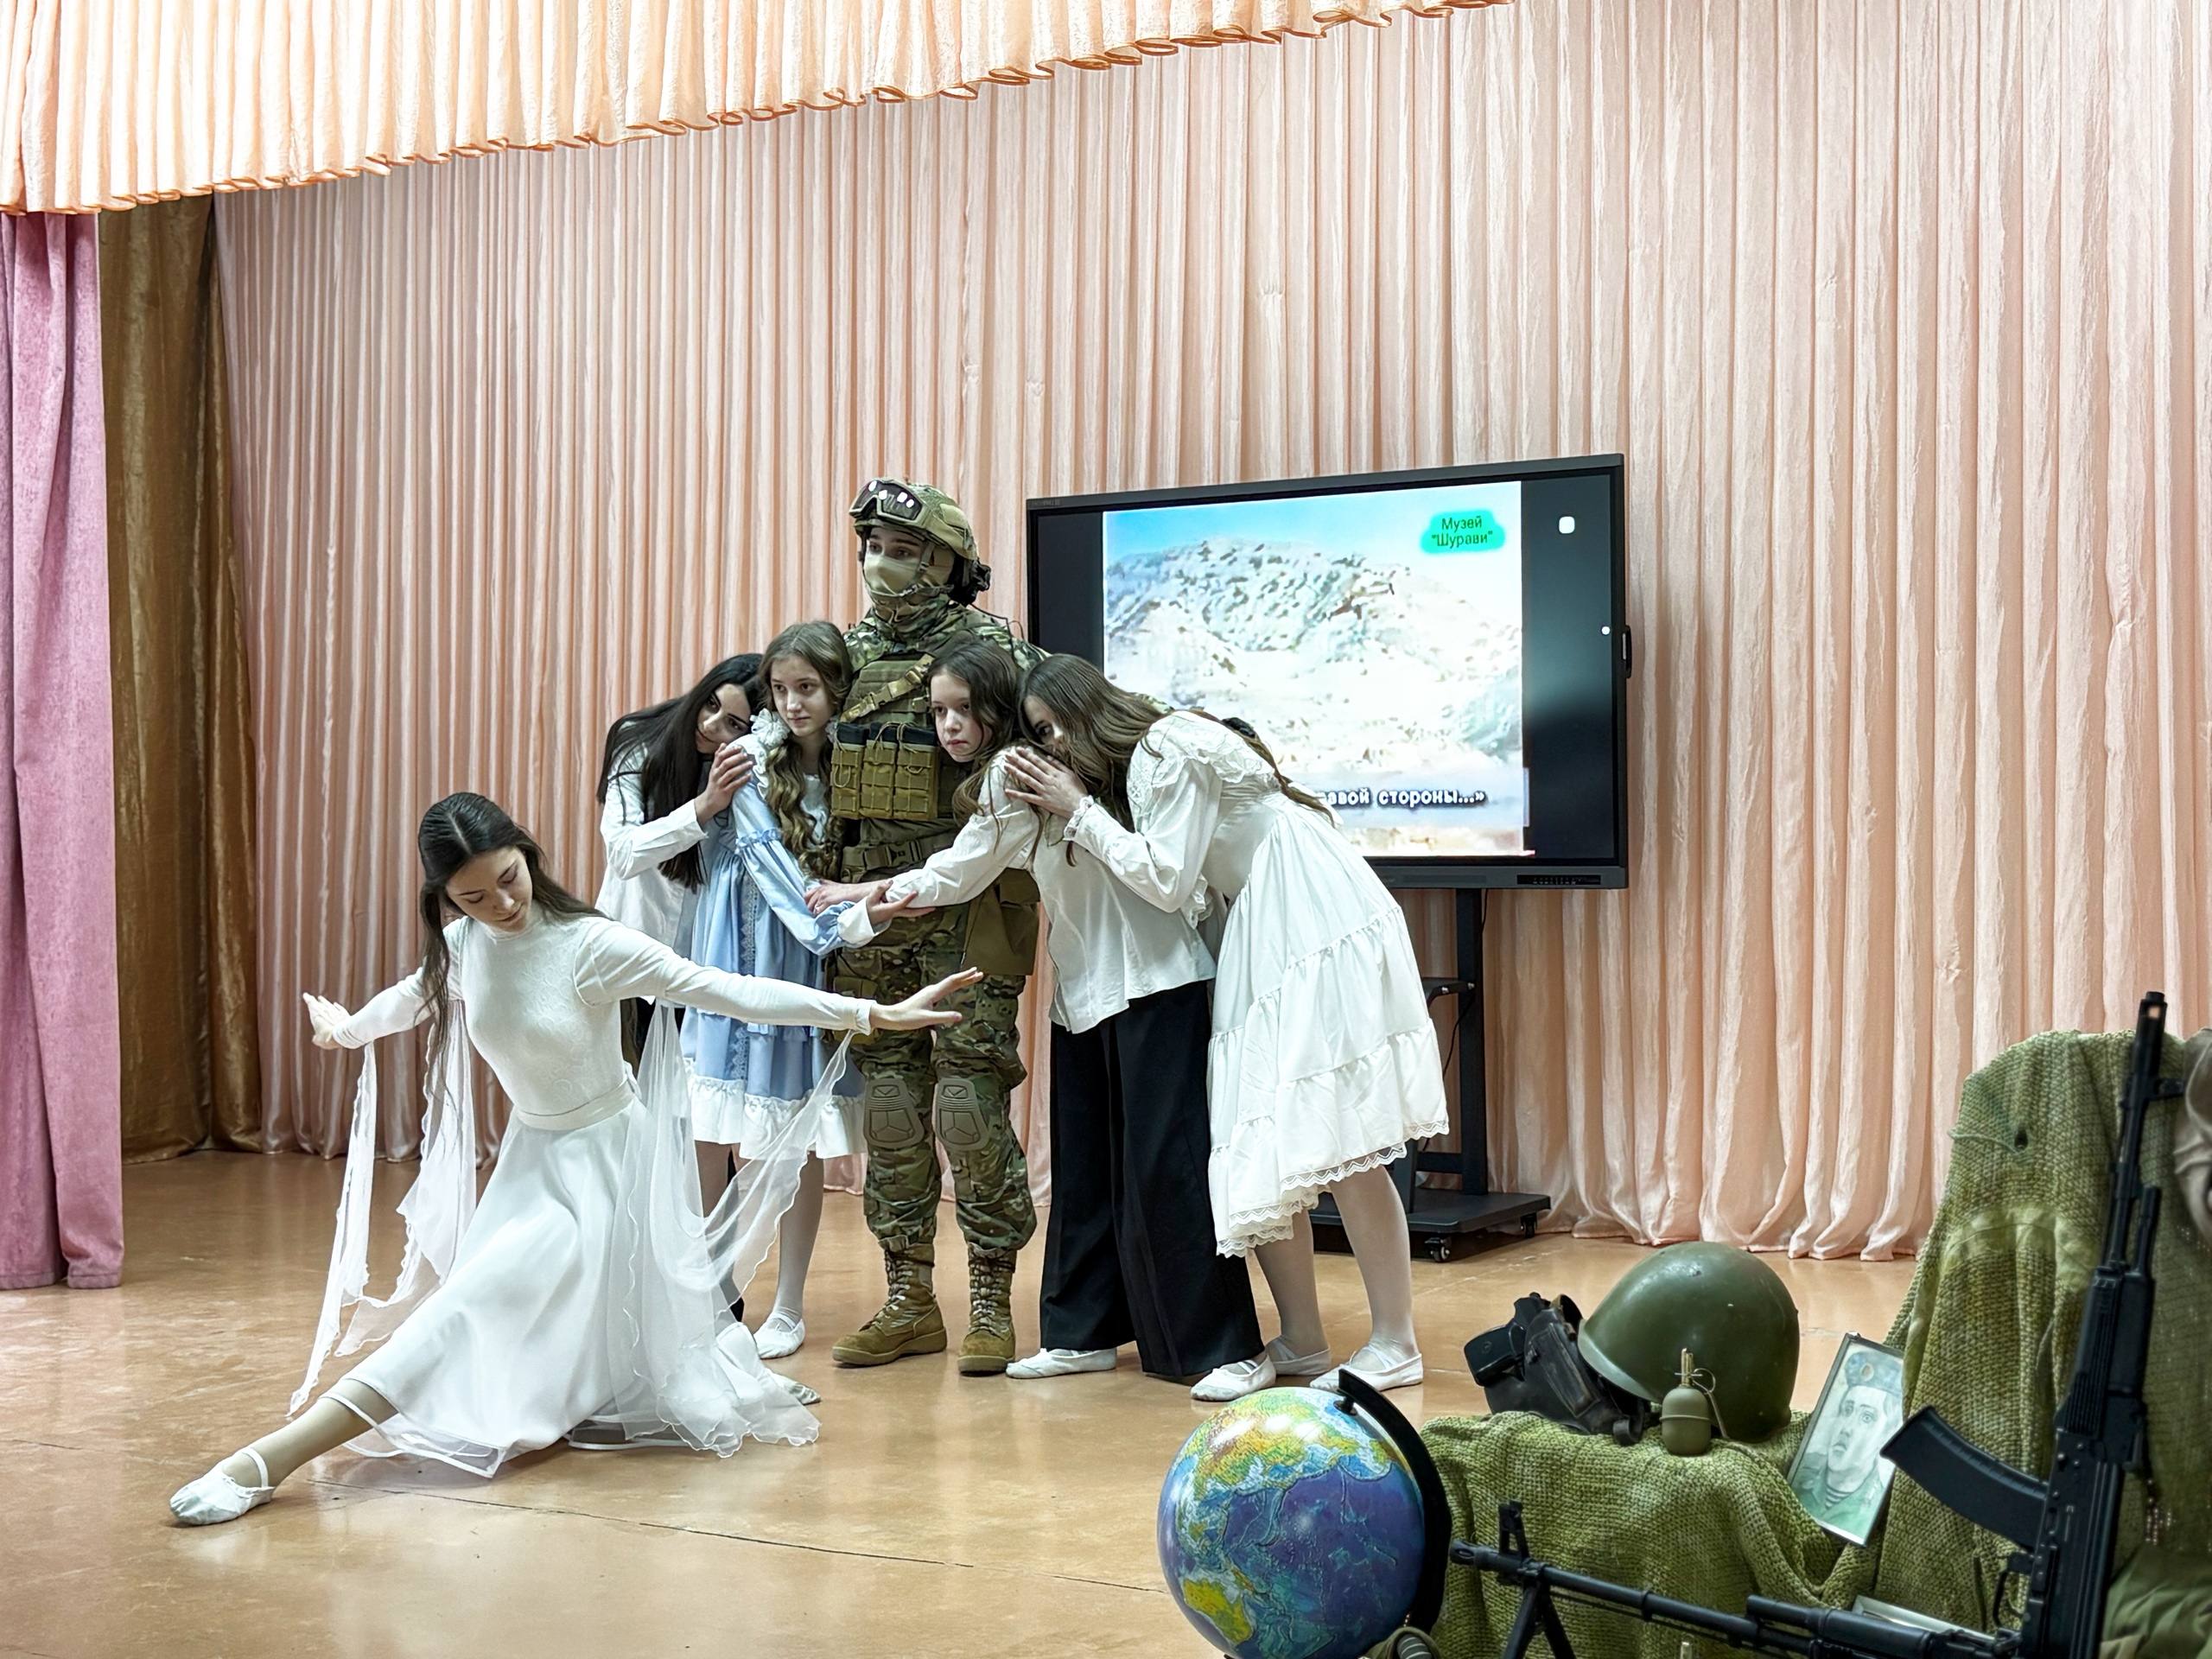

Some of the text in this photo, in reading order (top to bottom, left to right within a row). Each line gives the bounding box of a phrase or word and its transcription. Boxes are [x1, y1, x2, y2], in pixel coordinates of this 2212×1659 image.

[1441, 515, 1482, 532] Музей
[1432, 531, 1493, 549] "Шурави"
[1378, 790, 1485, 808] стороны...»
